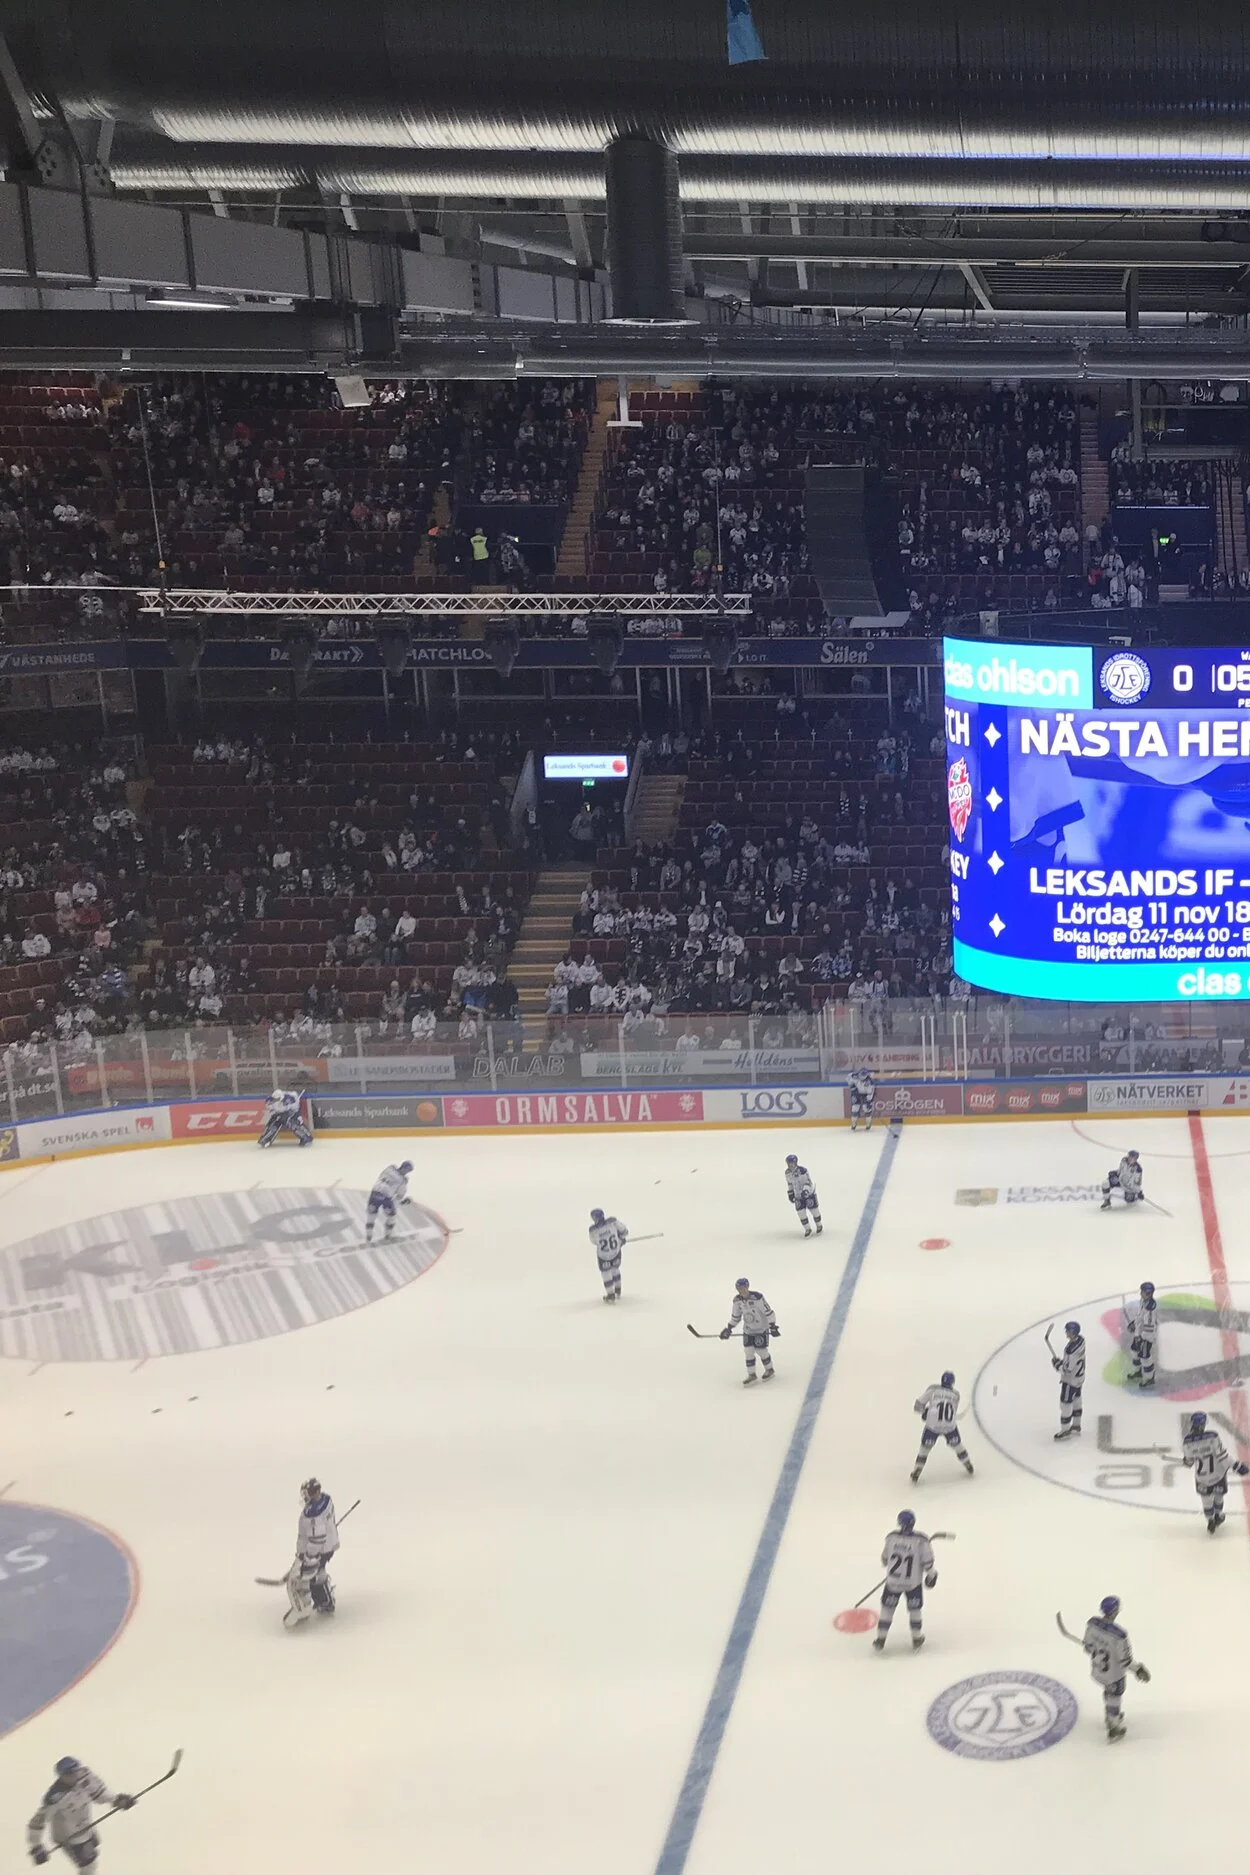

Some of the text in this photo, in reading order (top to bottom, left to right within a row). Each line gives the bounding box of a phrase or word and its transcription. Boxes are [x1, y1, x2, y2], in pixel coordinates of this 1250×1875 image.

[821, 642, 869, 665] Sälen
[977, 656, 1080, 697] ohlson
[1173, 664, 1194, 692] 0
[1020, 712, 1169, 757] NÄSTA
[1029, 867, 1198, 896] LEKSANDS
[1204, 868, 1235, 895] IF
[1056, 901, 1143, 928] Lördag
[1148, 902, 1167, 924] 11
[1174, 906, 1220, 924] nov
[1053, 928, 1091, 943] Boka
[1094, 928, 1127, 945] loge
[1129, 928, 1205, 944] 0247-644
[1207, 928, 1230, 942] 00
[1076, 945, 1156, 962] Biljetterna
[1159, 945, 1202, 961] köper
[1205, 944, 1225, 958] du
[1177, 966, 1242, 995] clas
[472, 1055, 565, 1078] DALAB
[970, 1091, 995, 1104] mix
[1008, 1094, 1031, 1106] mix
[1041, 1091, 1060, 1104] mix
[1117, 1083, 1205, 1099] NÄTVERKET
[496, 1094, 653, 1124] ORMSALVA
[741, 1091, 808, 1119] LOGS
[187, 1109, 267, 1130] CC
[41, 1126, 131, 1147] SVENSKA SPEL
[599, 1235, 618, 1252] 26
[936, 1401, 954, 1422] 10
[888, 1553, 914, 1580] 21
